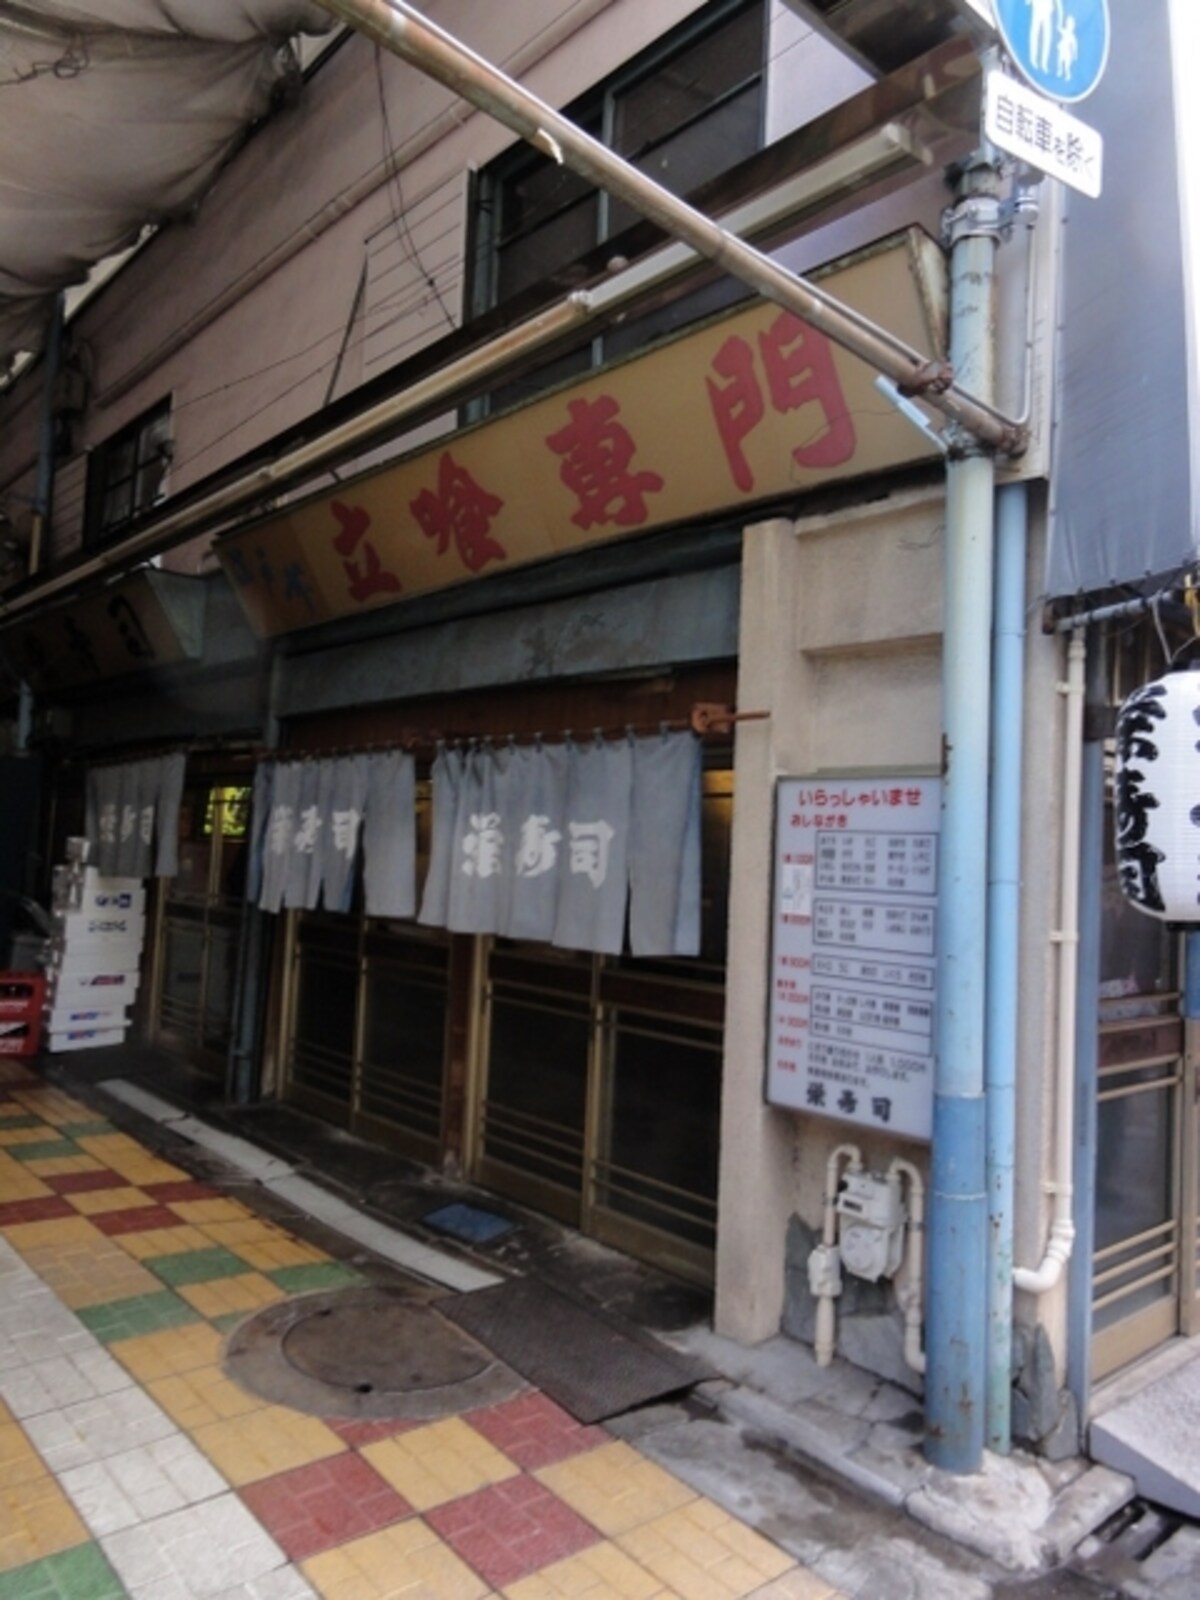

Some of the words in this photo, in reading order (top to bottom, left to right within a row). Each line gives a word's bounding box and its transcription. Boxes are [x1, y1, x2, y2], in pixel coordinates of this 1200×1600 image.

[997, 94, 1094, 180] 自転車を除く
[798, 788, 922, 807] いらっしゃいませ
[790, 814, 849, 828] おしながき
